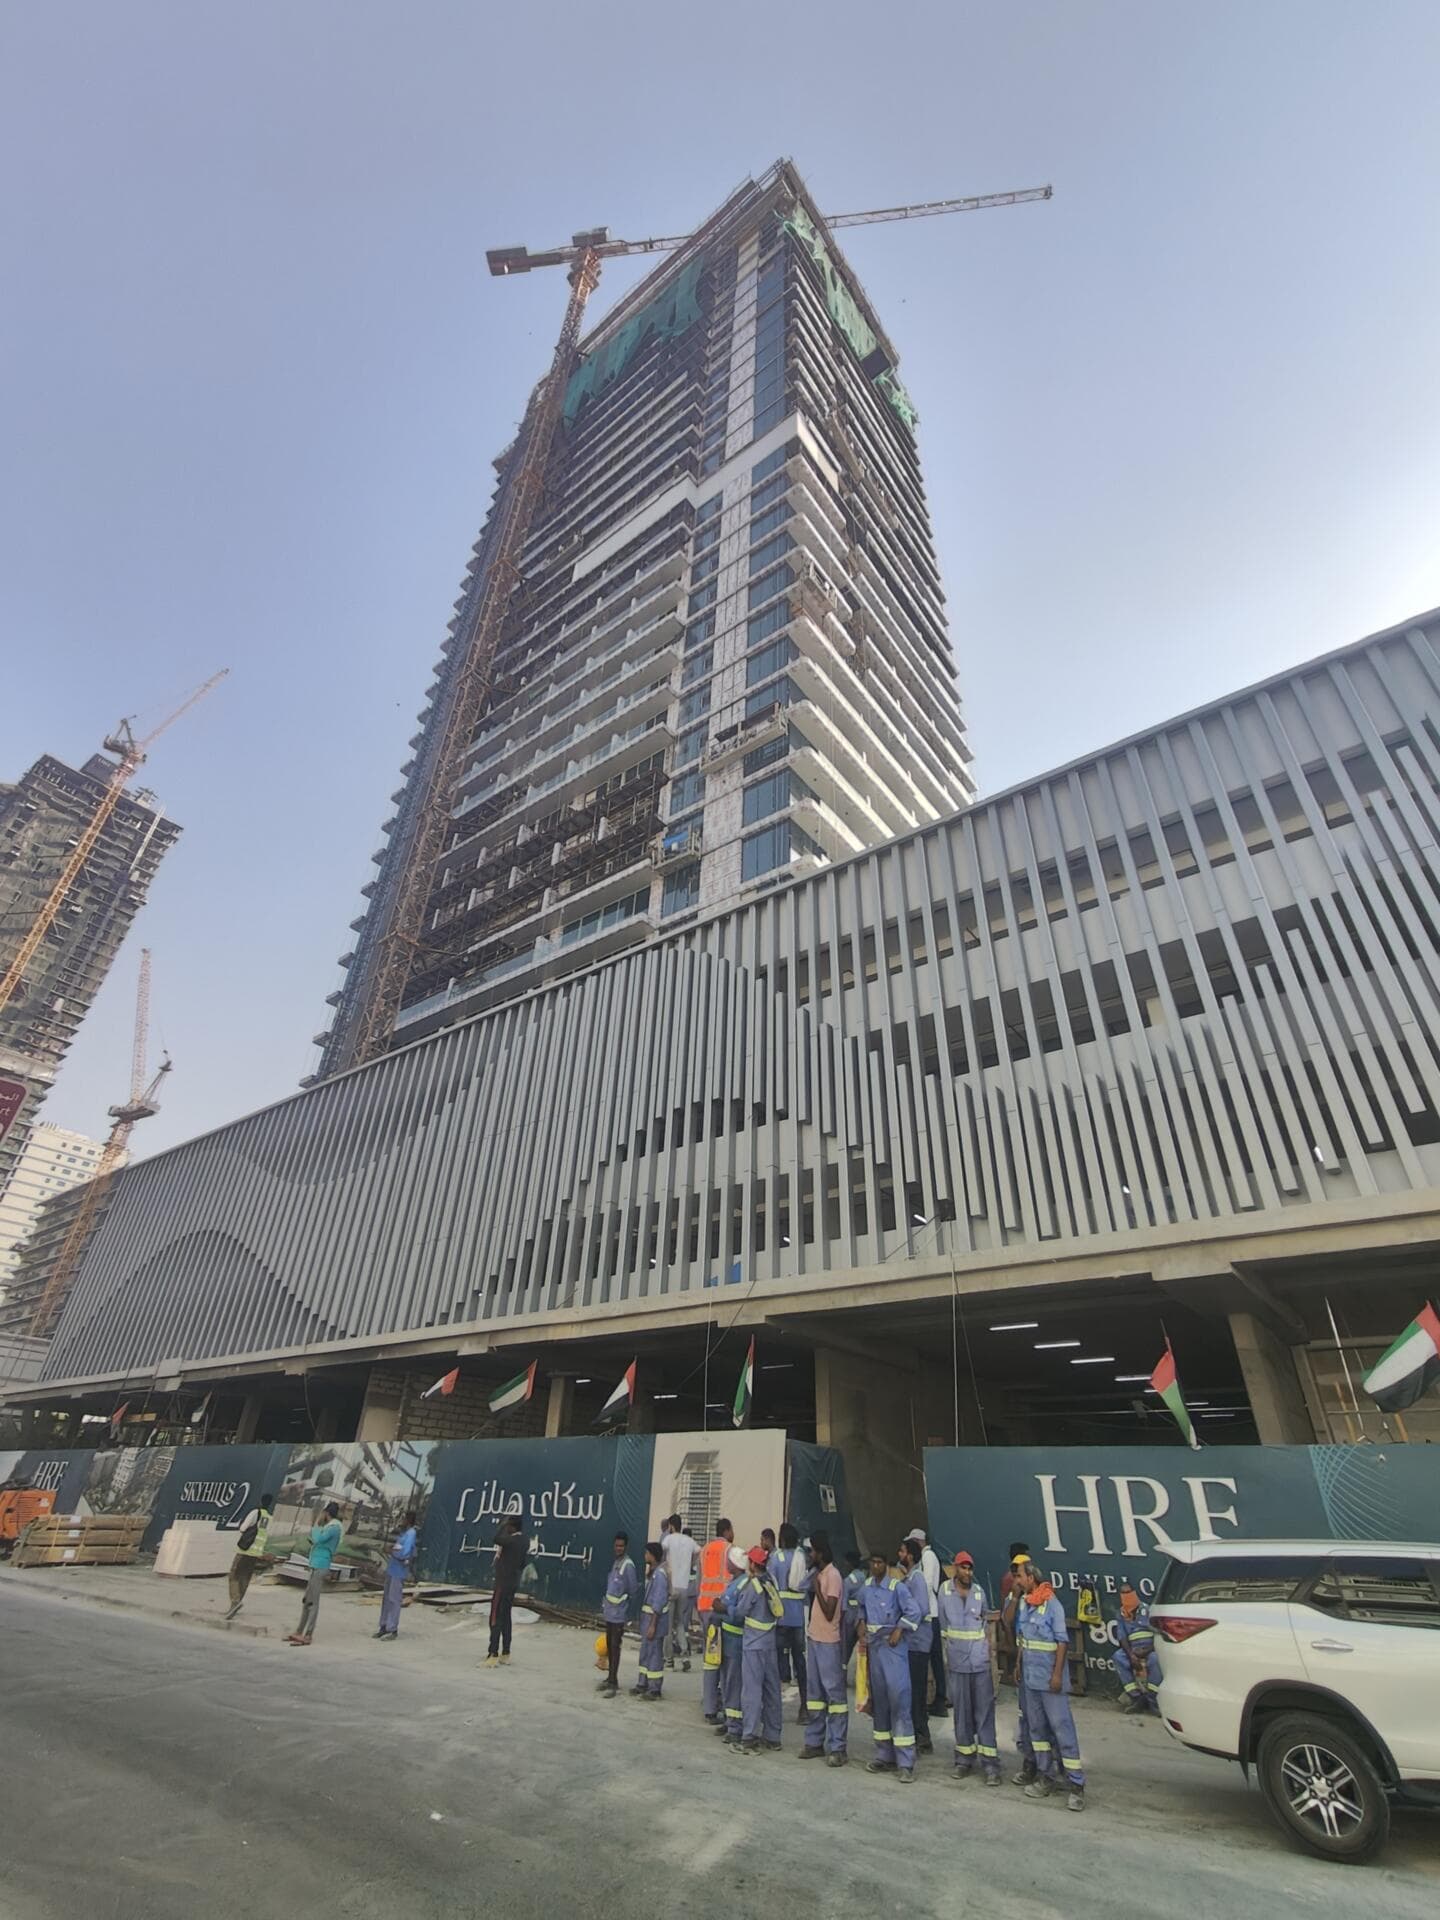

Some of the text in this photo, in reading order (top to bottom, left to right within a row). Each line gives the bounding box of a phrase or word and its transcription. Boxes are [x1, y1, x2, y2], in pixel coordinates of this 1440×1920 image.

[180, 1481, 251, 1527] SKYHILLS 2
[472, 1479, 523, 1524] هيلز
[529, 1481, 605, 1527] سكاي
